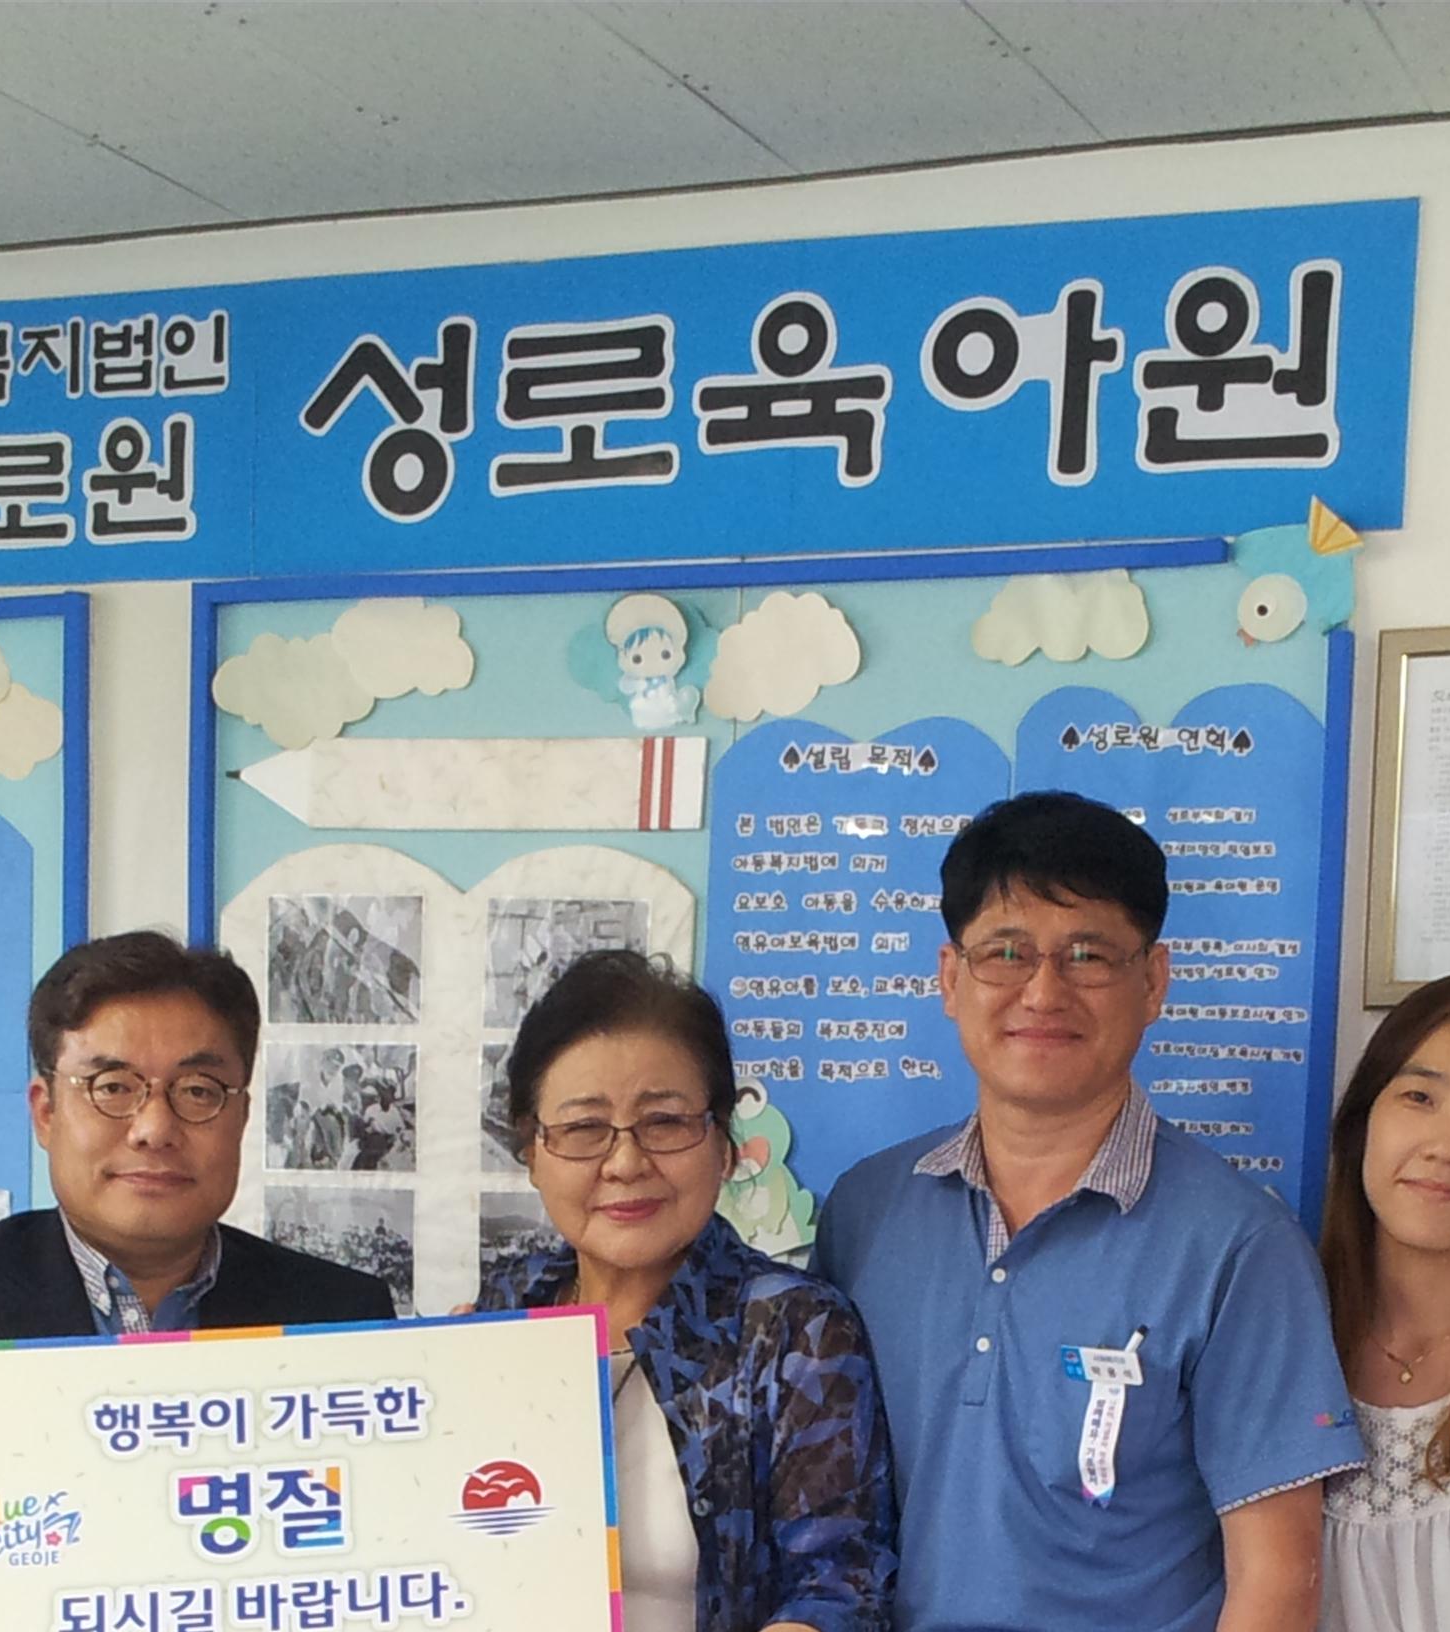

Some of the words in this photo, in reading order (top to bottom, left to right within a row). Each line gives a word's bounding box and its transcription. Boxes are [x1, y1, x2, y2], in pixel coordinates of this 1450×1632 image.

[304, 264, 1338, 516] 성로육아원
[1086, 725, 1160, 751] 성로원
[1177, 727, 1227, 753] 연혁
[806, 745, 851, 770] 설립
[868, 745, 912, 768] 목적
[737, 816, 754, 834] 본
[768, 815, 820, 835] 법인은
[733, 853, 838, 871] 아동복지법에
[852, 855, 886, 871] 의거
[736, 893, 786, 911] 요보호
[804, 892, 855, 912] 아동을
[735, 933, 857, 951] 영유아보육법에
[733, 1020, 801, 1037] 아동들의
[819, 1061, 888, 1081] 목적으로
[93, 1396, 247, 1451] 행복이
[270, 1385, 426, 1440] 가득한
[178, 1466, 345, 1555] 명절
[9, 1551, 60, 1566] GEOJE
[236, 1572, 466, 1632] 바랍니다.
